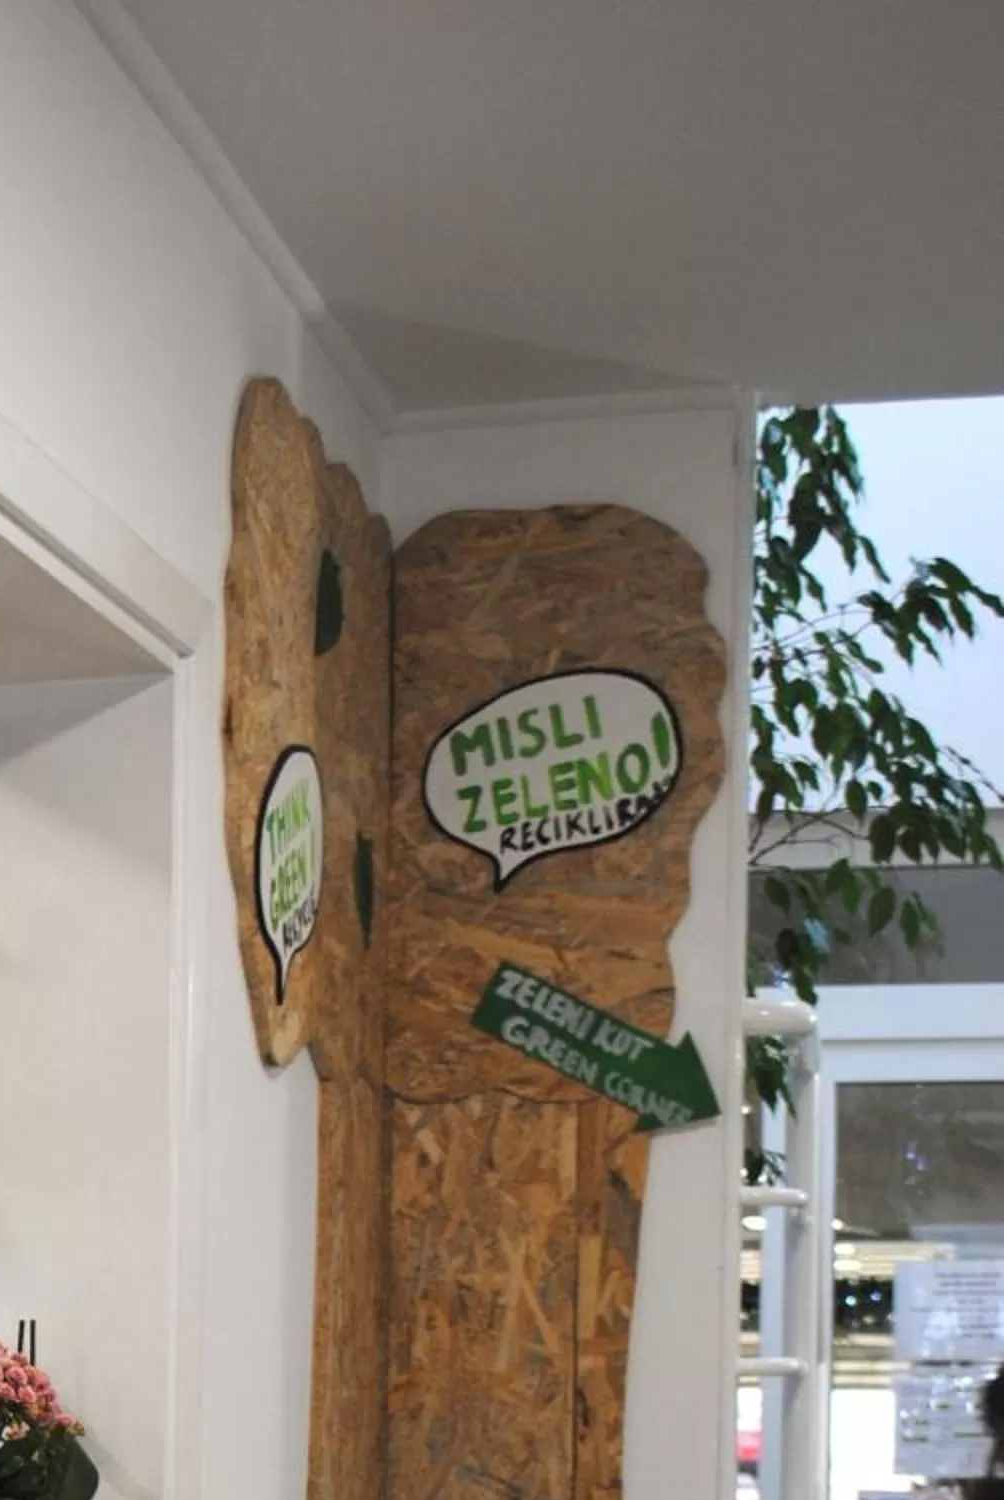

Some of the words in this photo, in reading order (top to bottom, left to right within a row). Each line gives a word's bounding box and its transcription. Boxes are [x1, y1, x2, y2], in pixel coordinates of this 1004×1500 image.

[448, 696, 603, 776] MISLI
[495, 969, 596, 1041] ZELENI
[592, 1018, 656, 1062] KUT
[500, 1016, 599, 1086] GREEN
